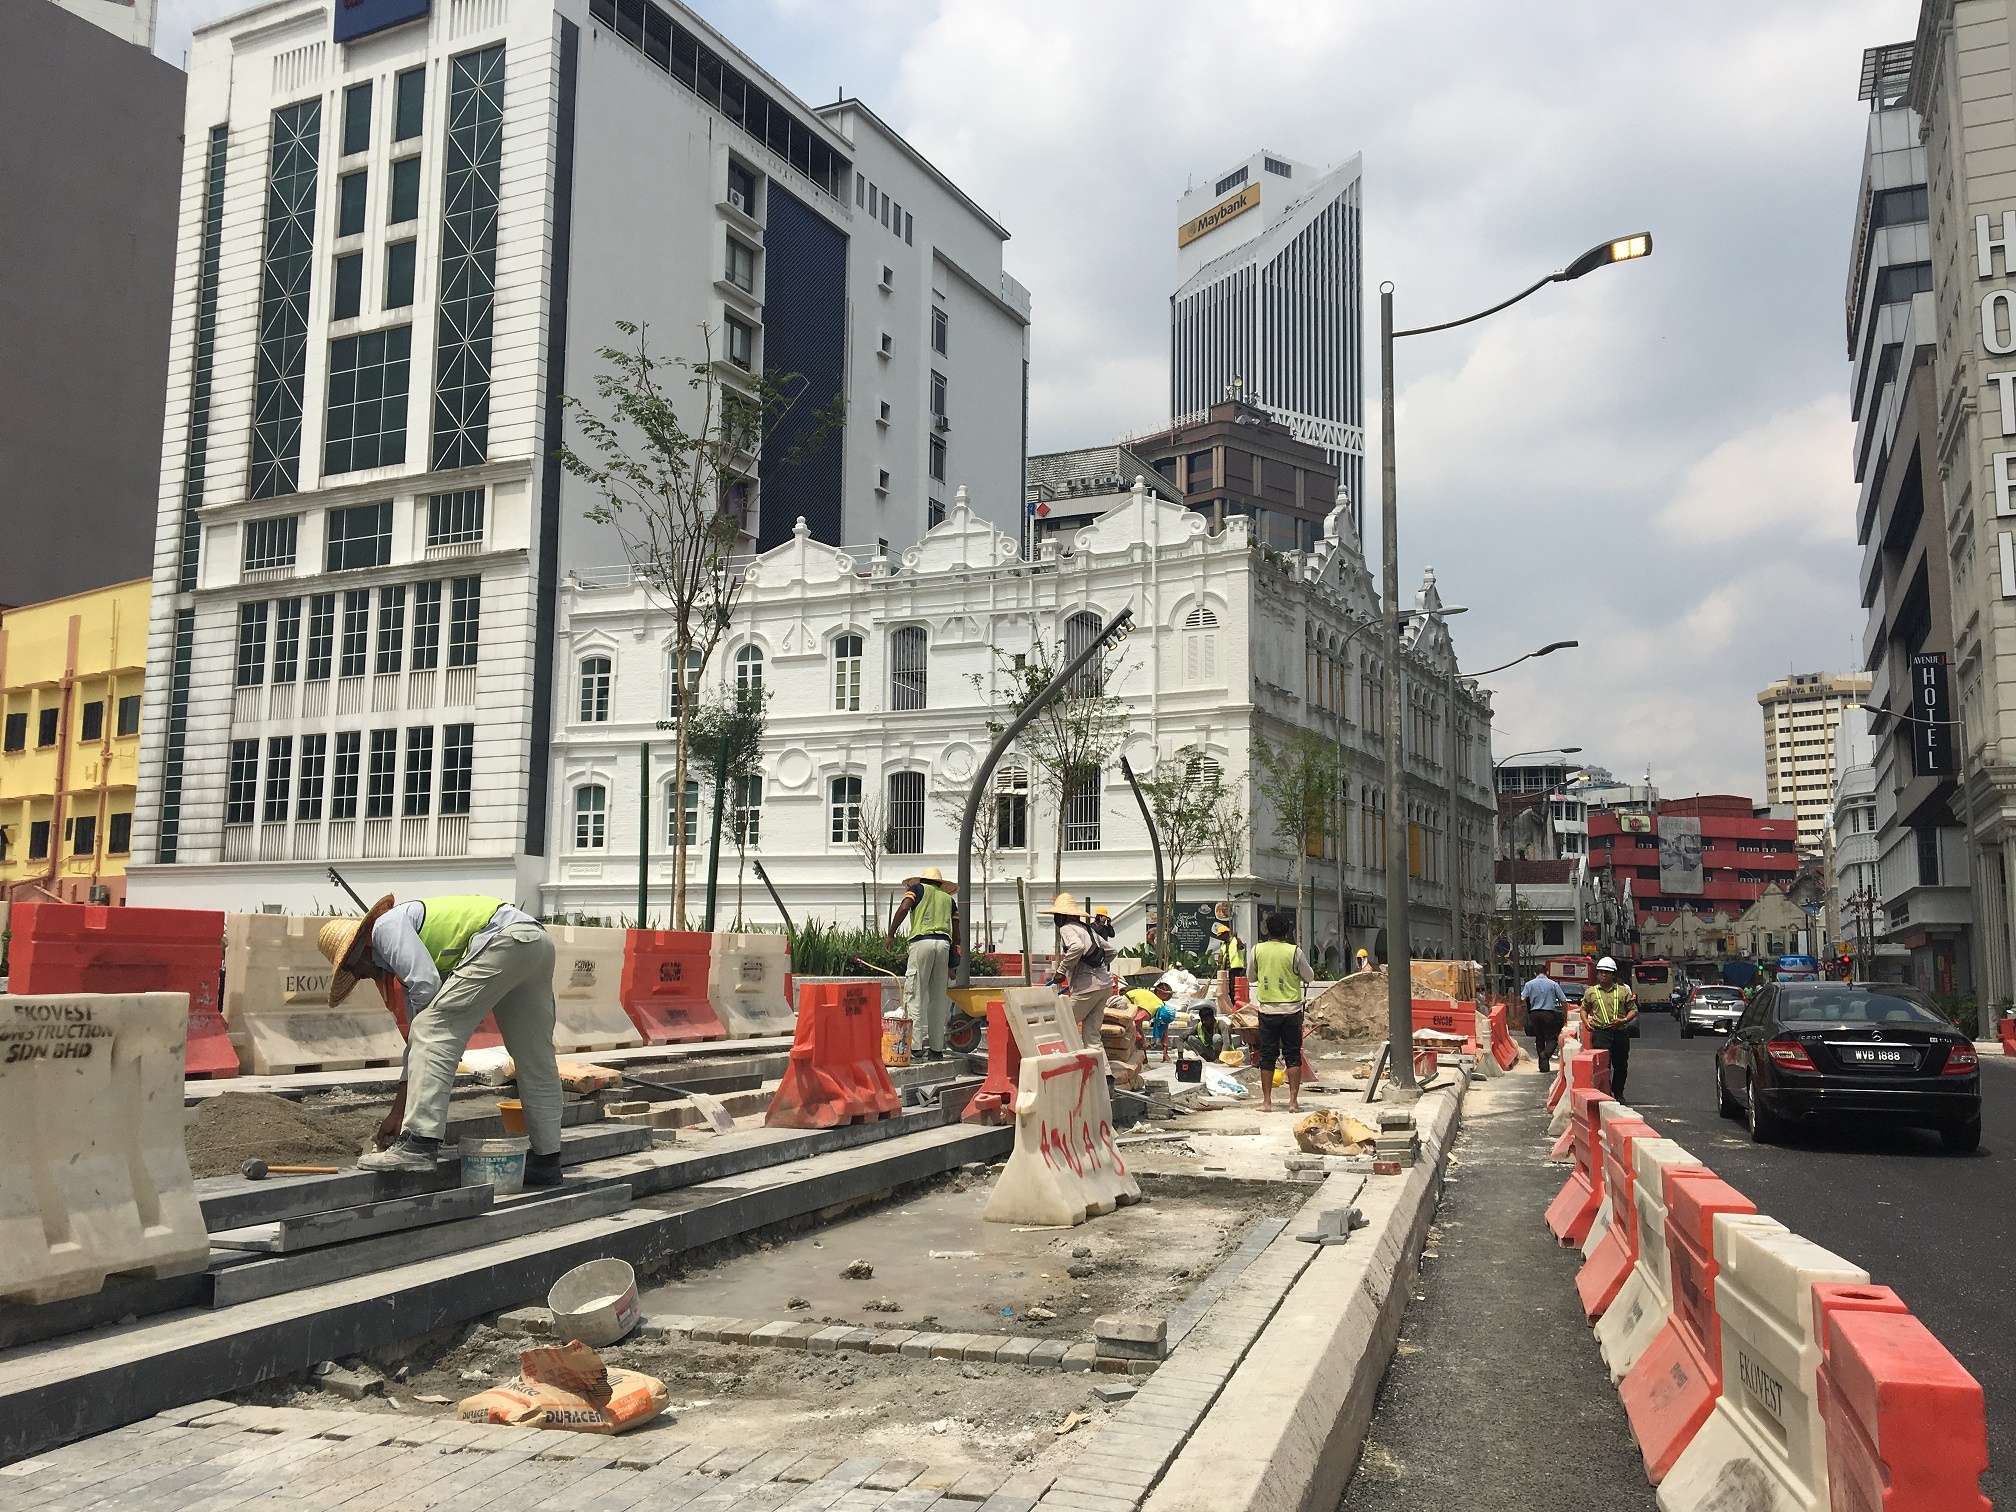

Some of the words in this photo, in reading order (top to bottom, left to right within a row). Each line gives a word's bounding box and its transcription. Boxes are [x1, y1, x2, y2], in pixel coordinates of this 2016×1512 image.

[1198, 194, 1248, 233] Maybank
[1974, 209, 2016, 600] HOTEL
[1913, 655, 1940, 665] AVENUE
[1922, 667, 1939, 769] HOTEL
[1176, 919, 1198, 928] Offers
[1177, 911, 1198, 920] Special
[286, 976, 330, 991] EKOV
[0, 1024, 113, 1041] ONSTRUCTION
[5, 1043, 49, 1063] SDN
[53, 1042, 93, 1059] BHD
[1855, 1050, 1875, 1060] WVB
[1878, 1051, 1901, 1061] 1888
[1040, 1110, 1125, 1178] AWAS
[1740, 1350, 1783, 1417] EKOVEST
[619, 1394, 634, 1405] TILE
